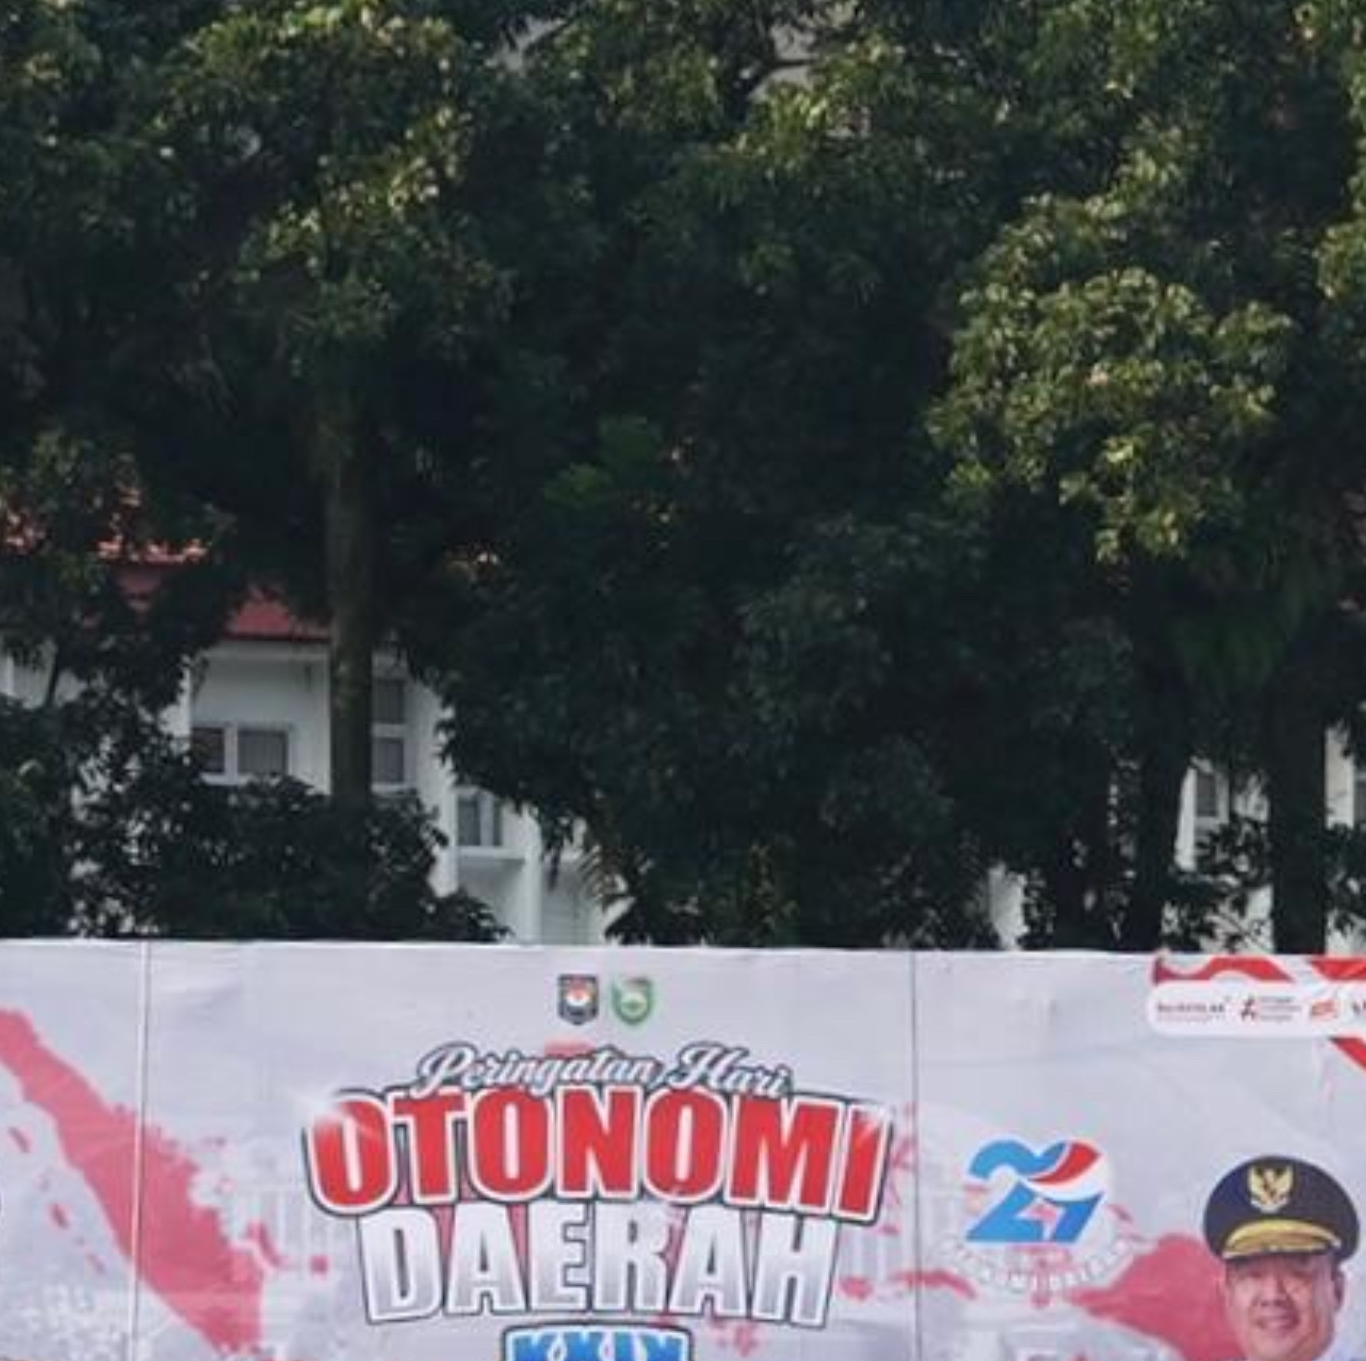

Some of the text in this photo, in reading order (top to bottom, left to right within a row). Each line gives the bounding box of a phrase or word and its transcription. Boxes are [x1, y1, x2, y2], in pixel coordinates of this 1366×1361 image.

[410, 1041, 793, 1099] Peringatan Hari
[308, 1088, 889, 1218] OTONOMI
[360, 1202, 839, 1325] DAERAH
